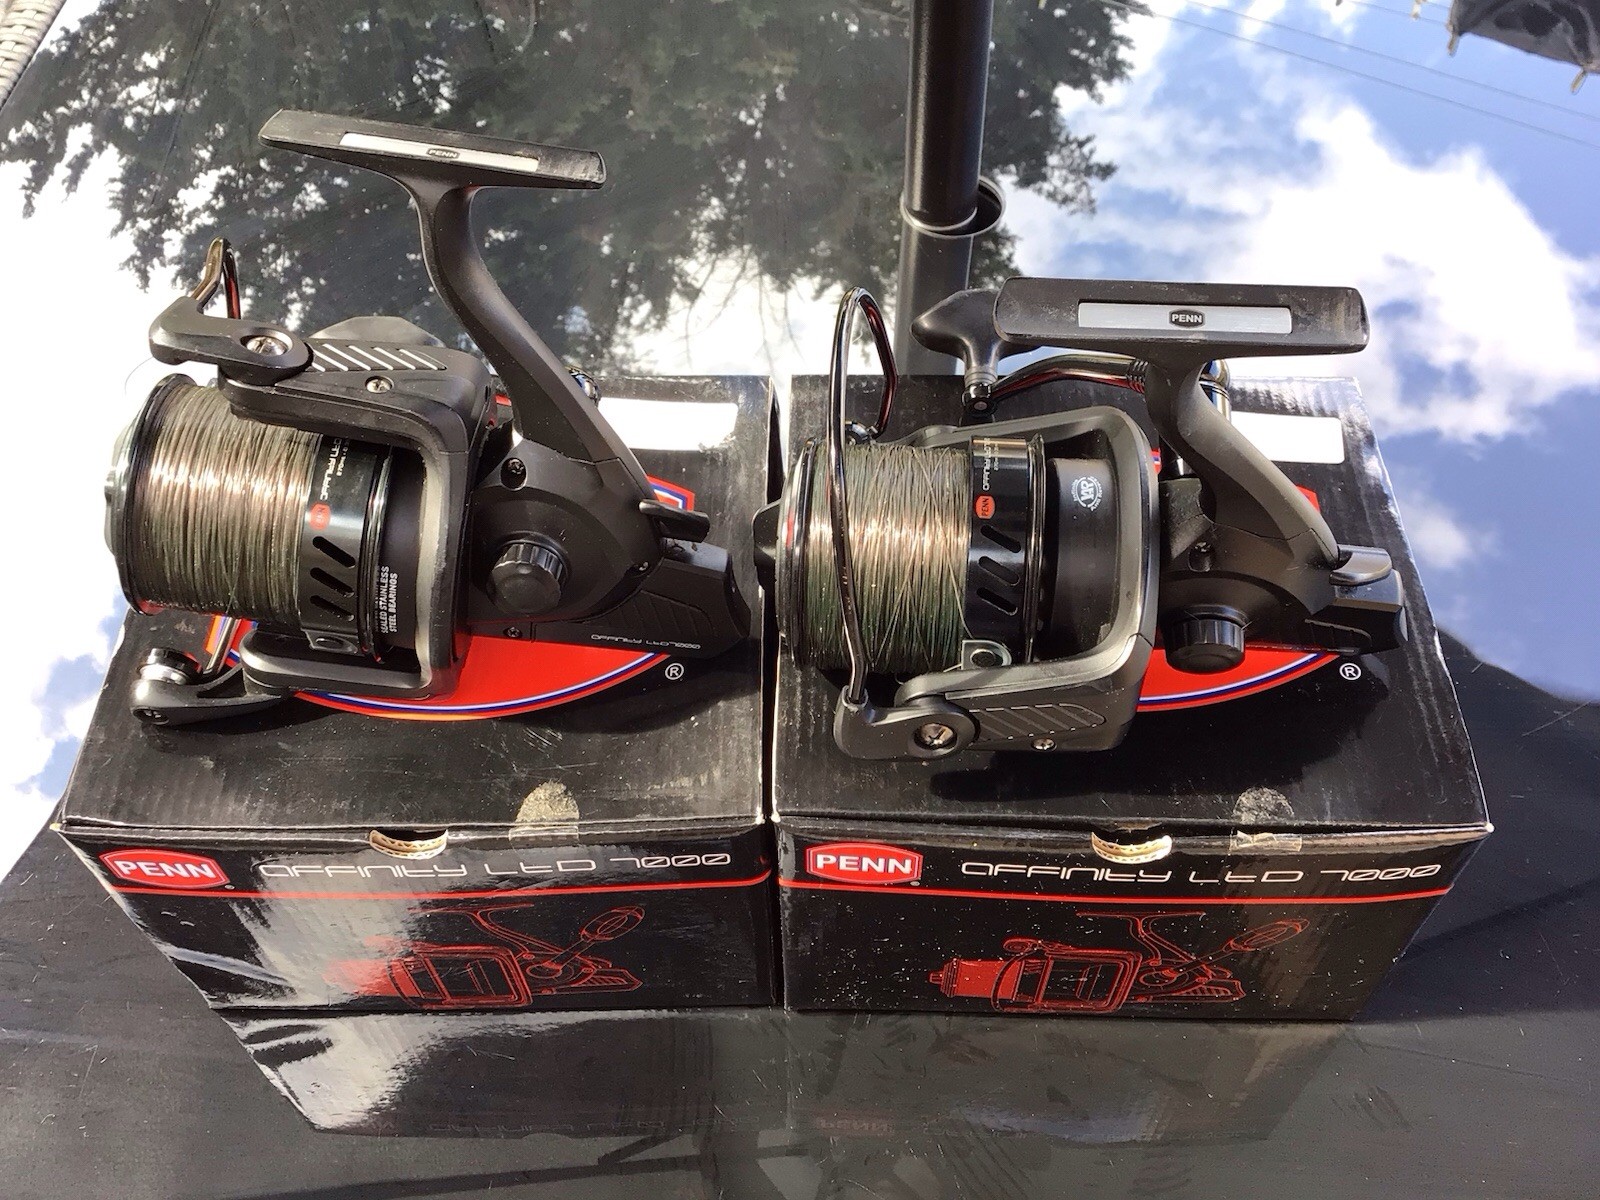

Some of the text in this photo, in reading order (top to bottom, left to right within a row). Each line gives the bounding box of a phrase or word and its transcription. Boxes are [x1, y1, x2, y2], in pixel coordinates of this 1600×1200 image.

[429, 149, 458, 158] PENN
[1171, 313, 1203, 323] PENN
[981, 497, 989, 516] PENN
[379, 566, 389, 611] STAINLESS
[388, 572, 398, 633] STEEL BEARINGS
[113, 860, 216, 880] PENN
[609, 852, 732, 870] 7000
[815, 853, 913, 875] PENN
[1319, 863, 1442, 882] 7000
